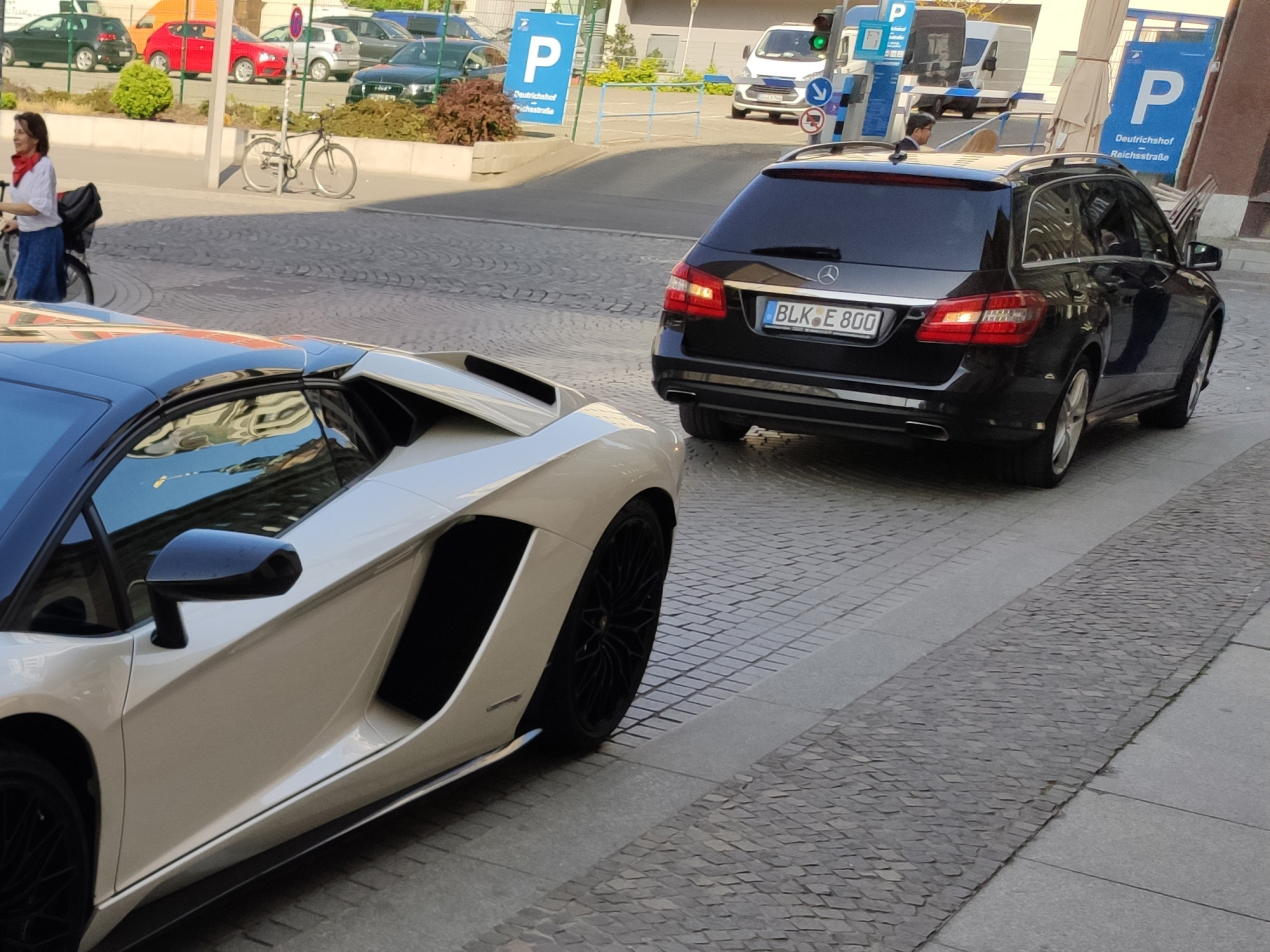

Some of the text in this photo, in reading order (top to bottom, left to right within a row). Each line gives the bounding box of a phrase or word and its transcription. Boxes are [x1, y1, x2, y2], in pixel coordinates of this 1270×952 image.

[888, 3, 906, 23] P
[523, 35, 562, 84] P
[513, 90, 558, 102] Deutrichshof
[1130, 69, 1185, 125] P
[1115, 133, 1174, 146] Deutrichshof
[1110, 149, 1169, 162] Reichsstraße
[775, 304, 878, 332] BLK E 800
